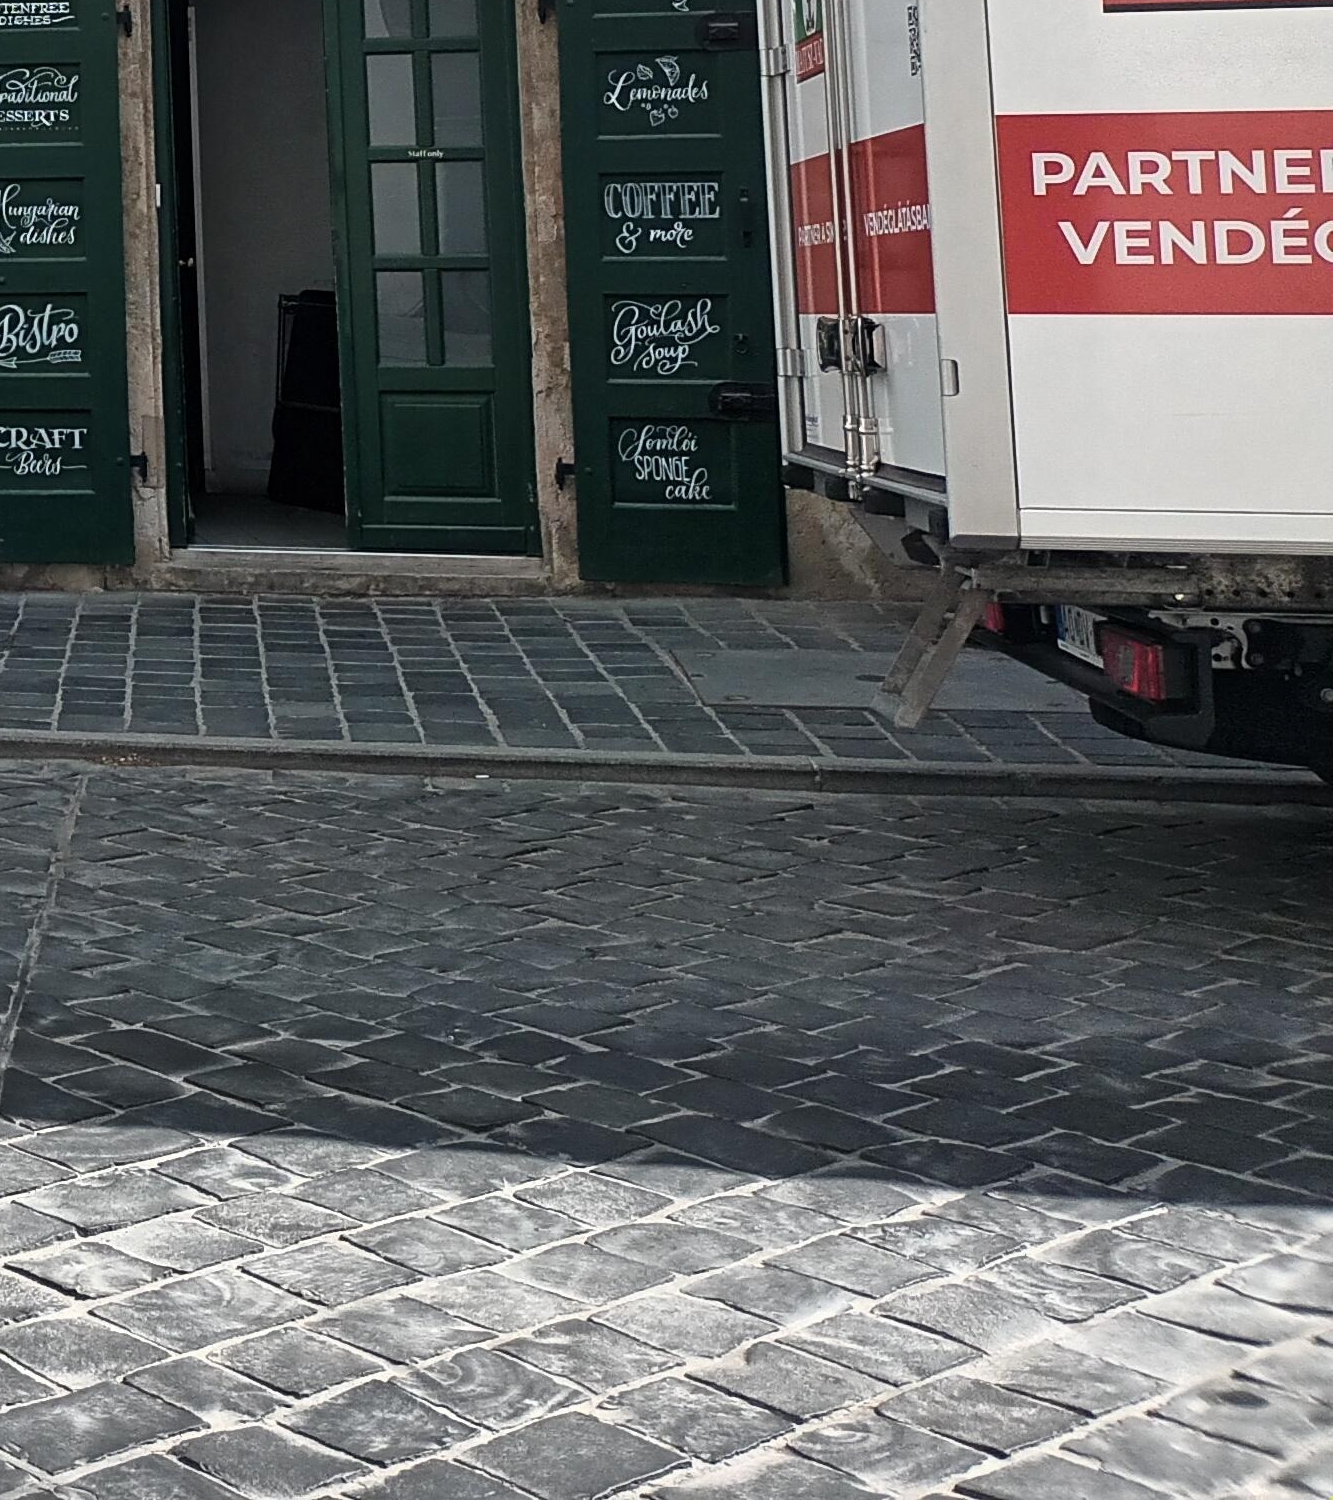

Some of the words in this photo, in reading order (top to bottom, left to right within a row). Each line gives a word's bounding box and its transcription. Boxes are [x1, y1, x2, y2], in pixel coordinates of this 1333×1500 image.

[603, 69, 709, 112] Lemonades
[407, 149, 426, 157] Staff
[427, 149, 444, 159] only
[604, 182, 721, 219] COFFEE
[19, 217, 78, 245] dishes
[615, 221, 642, 254] &
[649, 221, 694, 248] more
[611, 298, 721, 365] Goulash
[634, 342, 698, 375] soup
[618, 424, 699, 462] Somlói
[5, 449, 62, 476] Beers
[634, 455, 692, 482] SPONGE
[665, 467, 713, 500] cake
